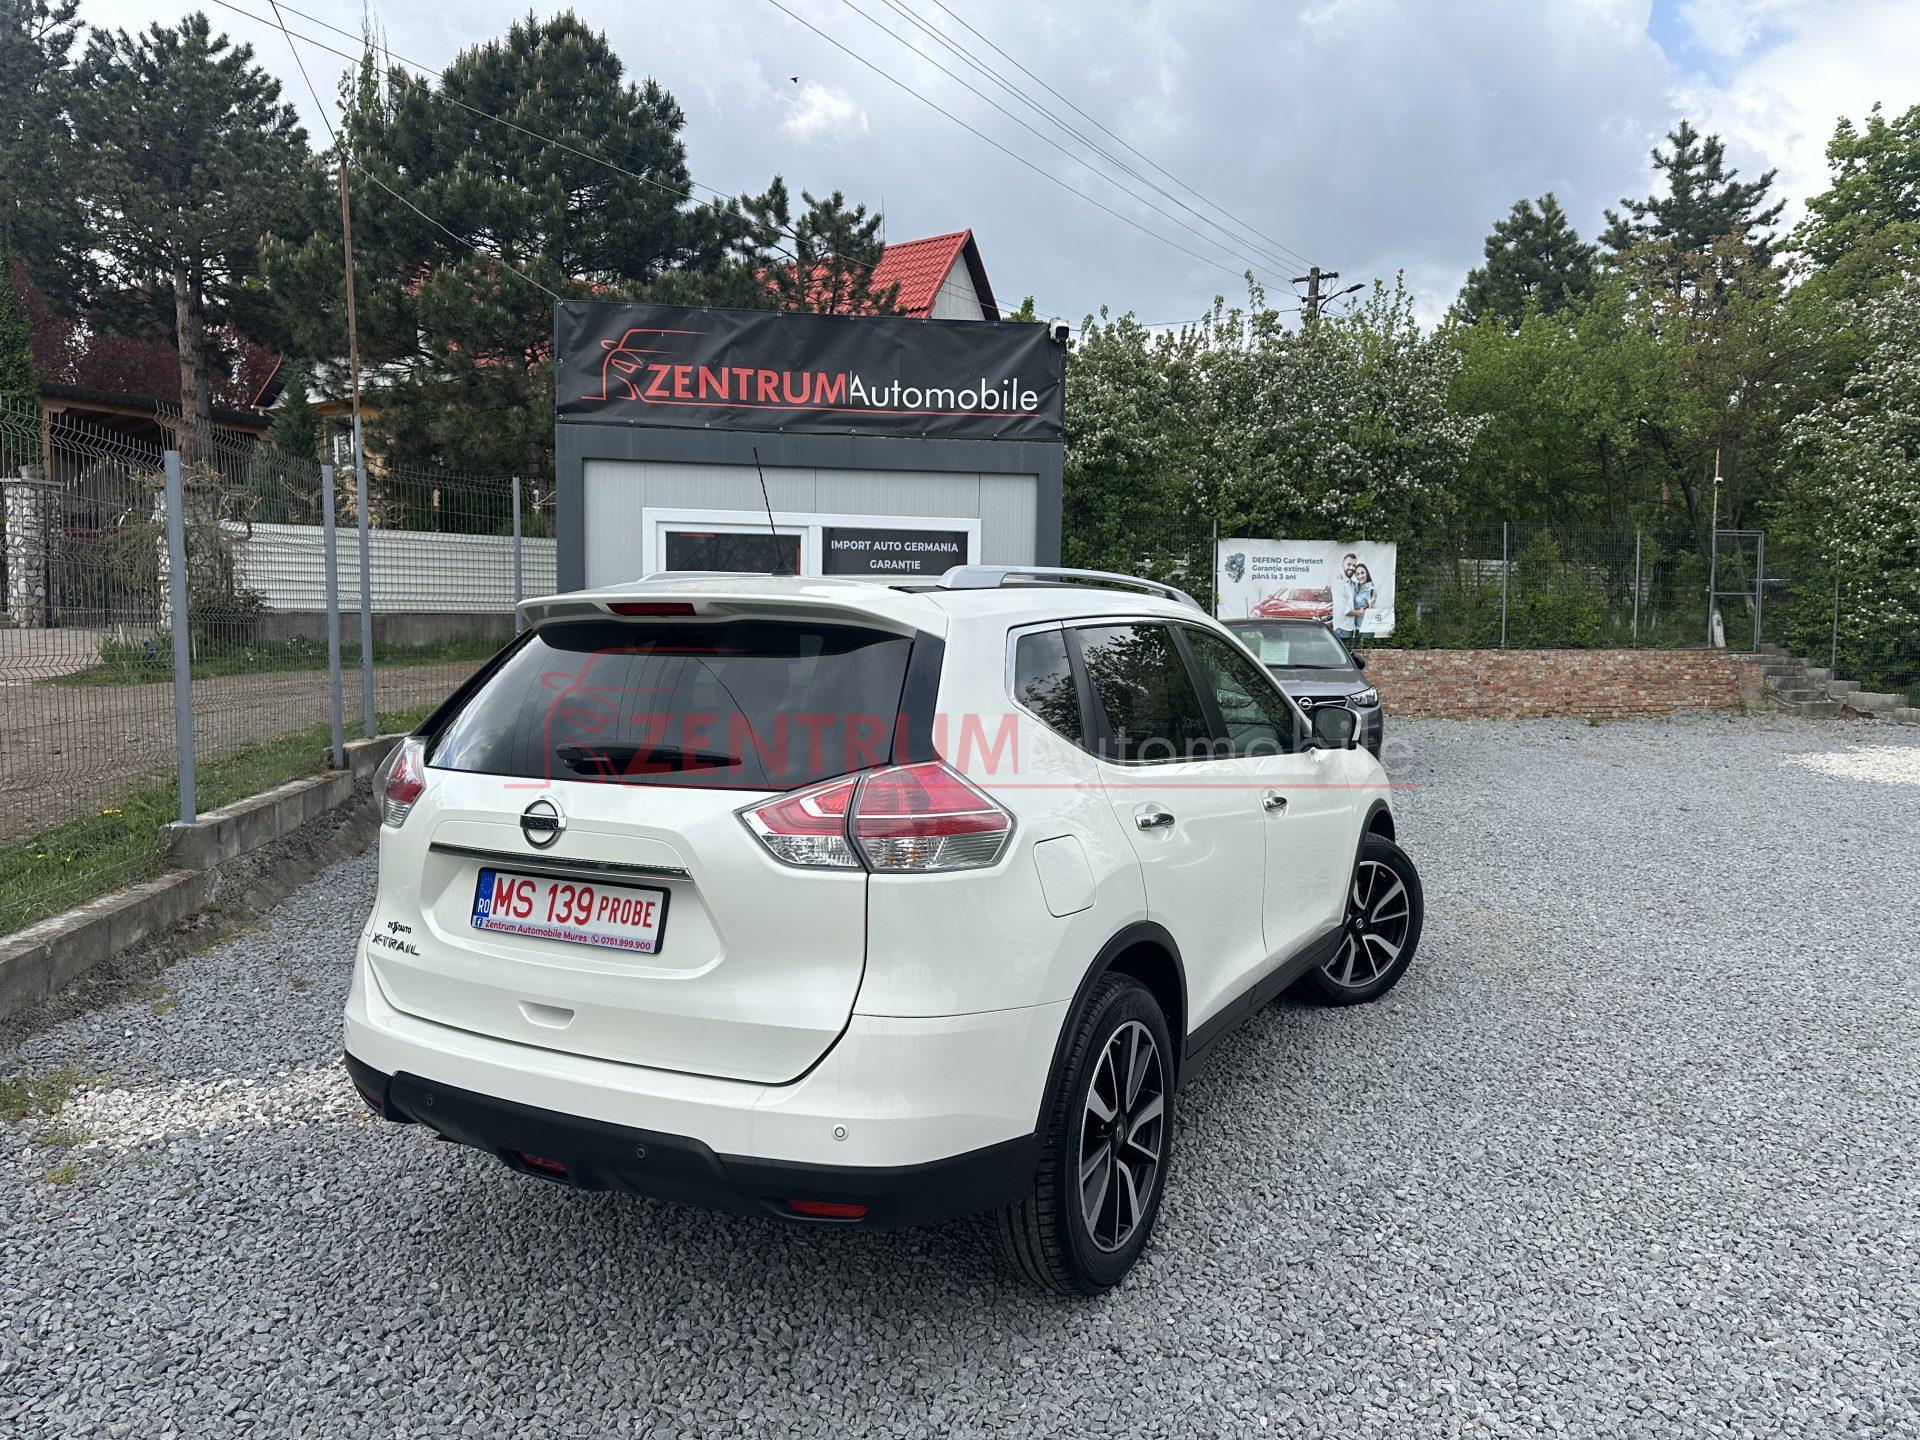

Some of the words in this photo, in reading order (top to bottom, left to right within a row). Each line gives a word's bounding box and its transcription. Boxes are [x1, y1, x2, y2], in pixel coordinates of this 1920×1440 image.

[645, 364, 847, 404] ZENTRUM
[850, 373, 1038, 411] Automobile
[831, 540, 871, 550] IMPORT
[873, 541, 902, 551] AUTO
[904, 542, 959, 552] GERMANIA
[869, 559, 921, 572] GARANȚIE
[1252, 556, 1282, 564] DEFEND
[477, 898, 491, 914] RO
[492, 877, 536, 918] MS
[546, 883, 595, 926] 139
[597, 895, 656, 928] PROBE
[372, 932, 421, 956] X-TRAIL
[485, 919, 516, 931] Zentrum
[518, 925, 562, 938] Automobile
[563, 931, 588, 943] Mures
[600, 936, 651, 950] 0751.999.900
